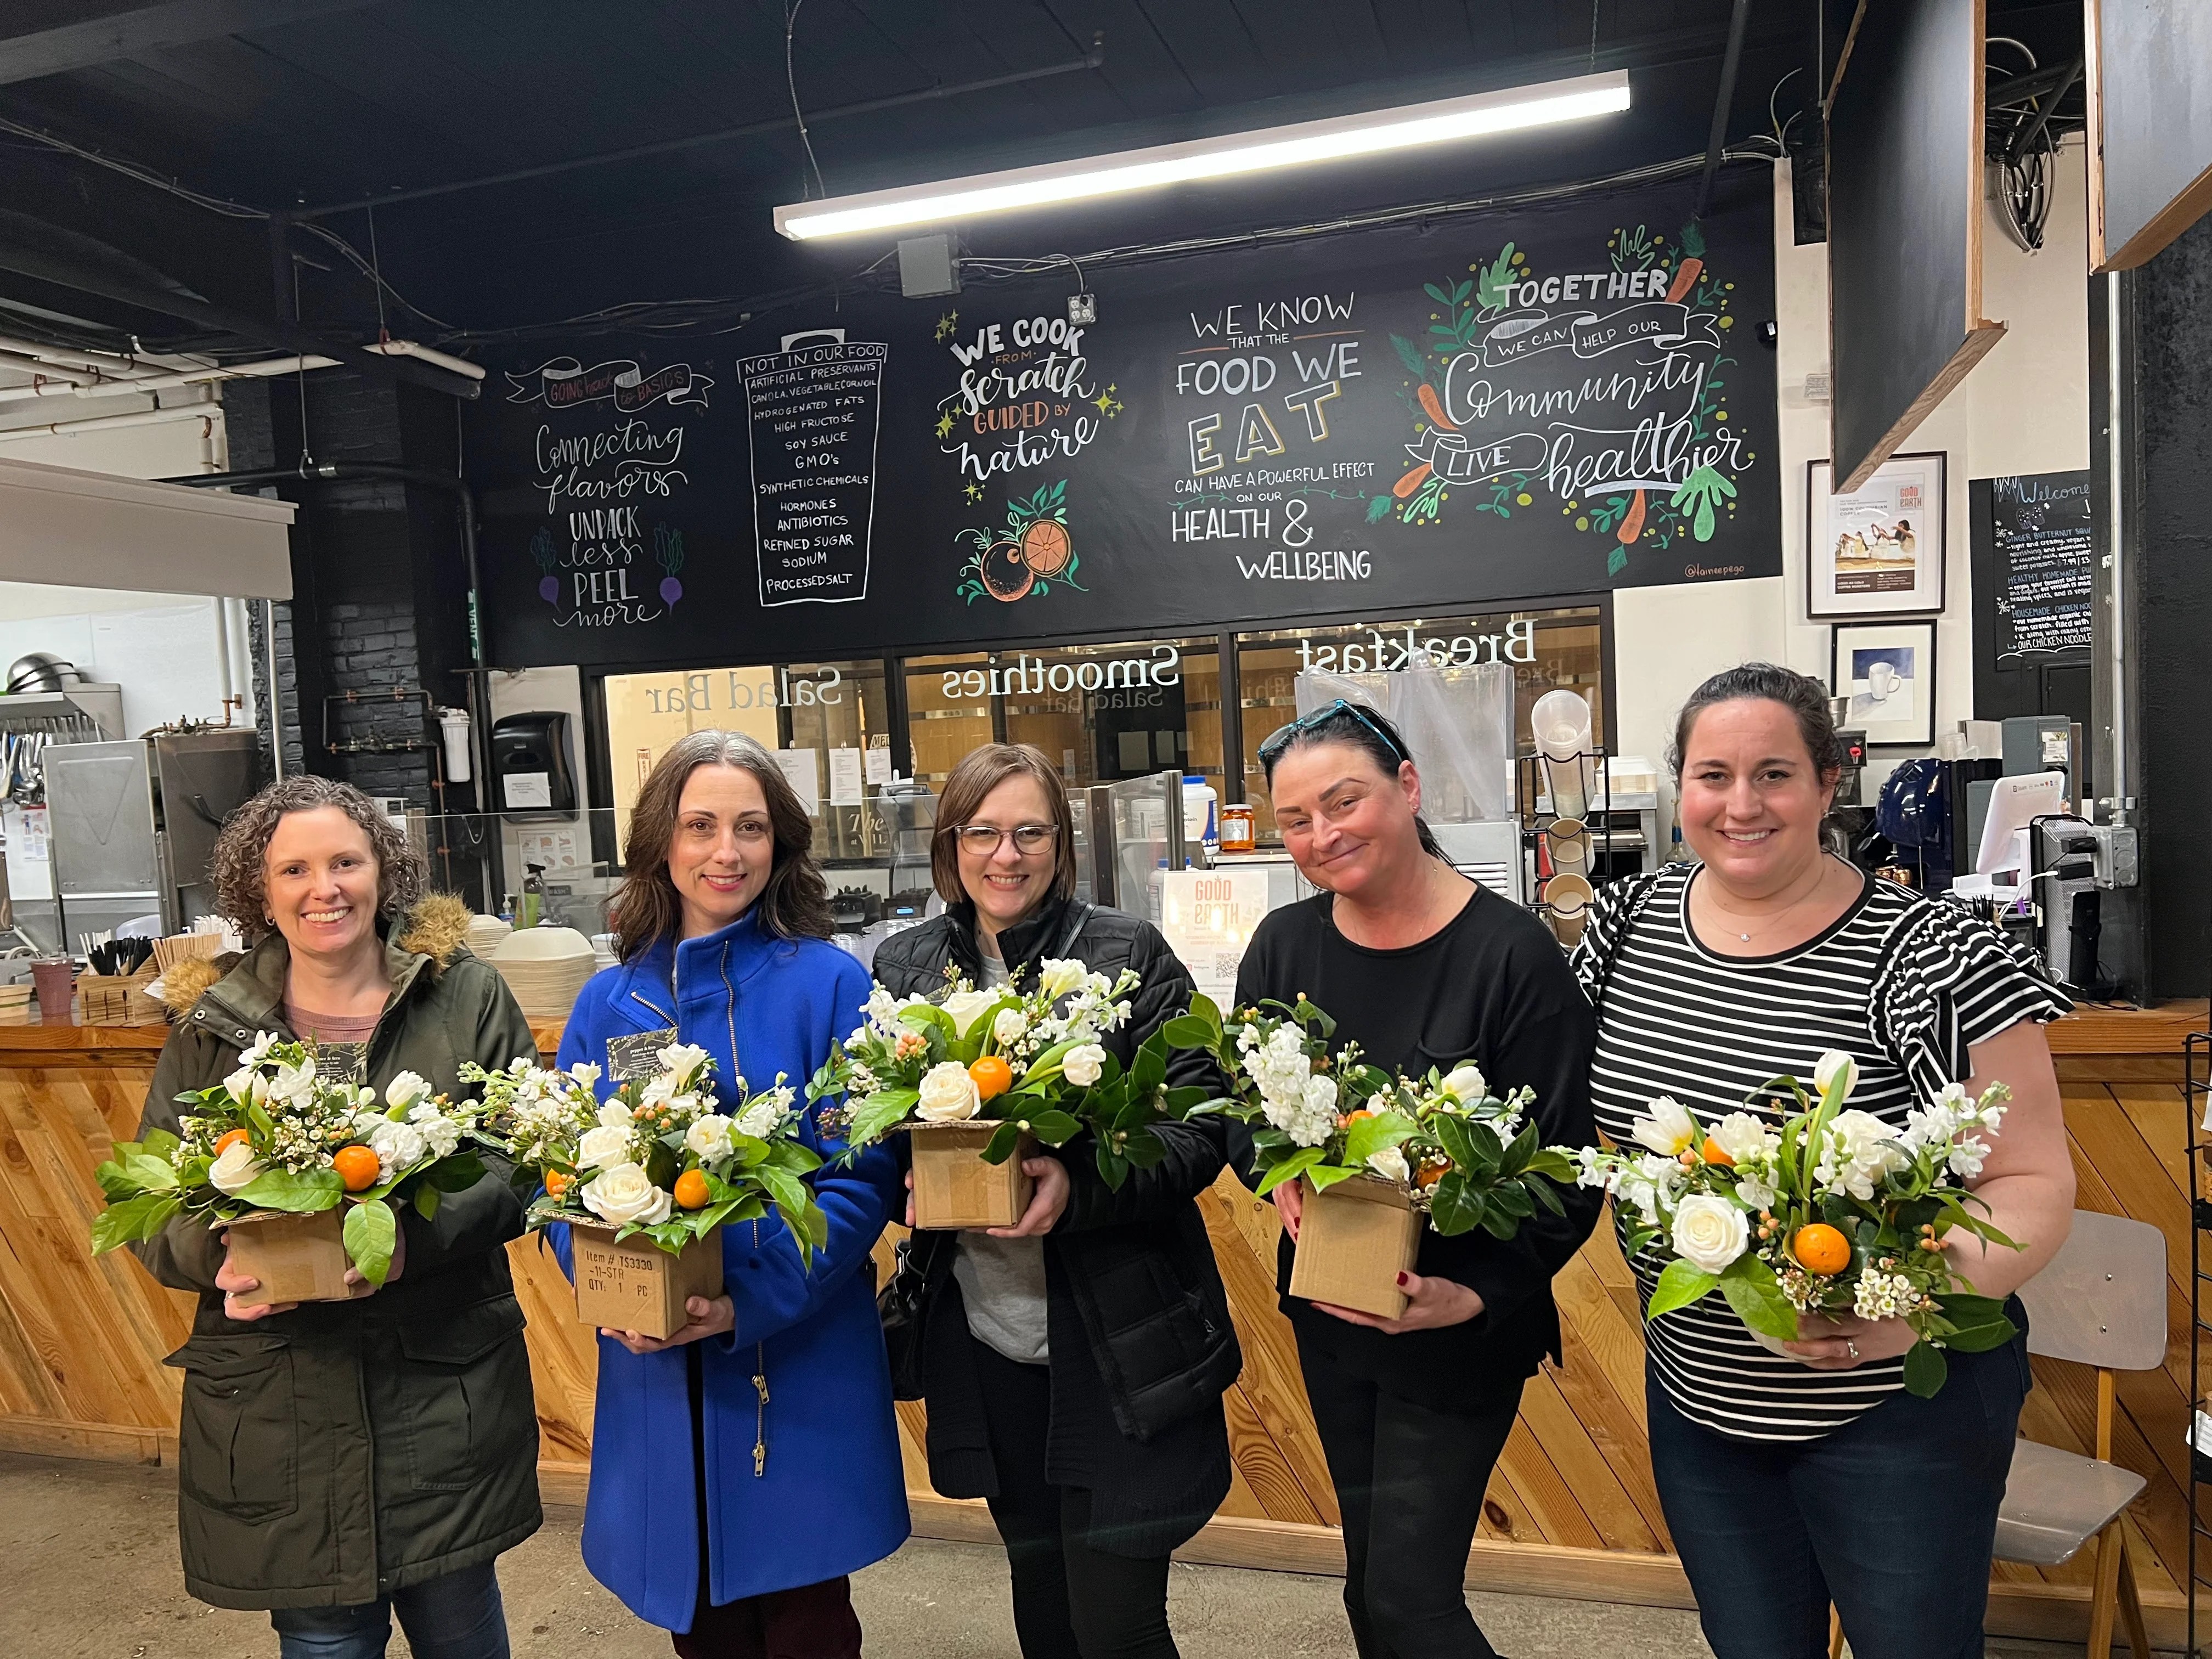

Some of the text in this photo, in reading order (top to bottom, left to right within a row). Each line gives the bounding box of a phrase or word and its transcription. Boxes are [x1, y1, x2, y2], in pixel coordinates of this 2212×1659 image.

[1493, 269, 1668, 308] TOGETHER
[1190, 291, 1354, 338] WE KNOW
[950, 317, 1084, 366] WE COOK
[1227, 333, 1290, 348] THAT THE
[1498, 320, 1661, 357] WE CAN HELP OUR
[745, 346, 885, 374] NOT IN OUR FOOD
[995, 350, 1032, 365] FROM
[1176, 342, 1362, 395] FOOD WE
[551, 379, 583, 402] GOING
[637, 371, 685, 400] BASICS
[751, 363, 876, 388] ARTIFICIAL PRESERVANTS
[1445, 351, 1704, 432] Community
[754, 396, 865, 420] HYDROGENATED FATS
[974, 401, 1071, 434] GUIDED BY
[775, 413, 855, 433] HIGH FRUCTOSE
[1188, 380, 1342, 476] EAT
[537, 418, 683, 477] Connecting
[785, 432, 848, 450] SOY SAUCE
[1447, 445, 1511, 476] LIVE
[1540, 411, 1754, 499] healthier
[532, 466, 688, 515] flavors
[1175, 462, 1374, 494] CAN HAVE A POWERFUL EFFECT
[780, 499, 837, 511] HORMONES
[1236, 492, 1282, 503] ON OUR
[1900, 487, 1918, 497] GOOD
[569, 505, 641, 541] UNPACK
[777, 516, 848, 531] ANTIBIOTICS
[1172, 499, 1313, 548] HEALTH &
[2006, 534, 2032, 543] GINGER
[2034, 529, 2072, 540] BUTTERNUT
[560, 538, 643, 567] less
[764, 534, 854, 551] REFINED SUGAR
[782, 551, 827, 568] SODIUM
[1235, 550, 1372, 581] WELLBEING
[574, 568, 639, 607] PEEL
[2007, 573, 2038, 585] HEALTHY
[2042, 568, 2078, 580] HOMEMADE
[553, 602, 662, 627] more
[2011, 606, 2051, 618] HOUSEMADE
[2055, 603, 2079, 613] CHICKEN
[468, 610, 477, 640] VENT
[2018, 633, 2091, 650] OUR CHICKEN NOODLE
[1195, 878, 1231, 901] GOOD
[1195, 903, 1239, 927] EATH
[586, 1250, 652, 1271] Item # TS3330
[618, 1282, 622, 1293] 1
[637, 1285, 648, 1296] PC
